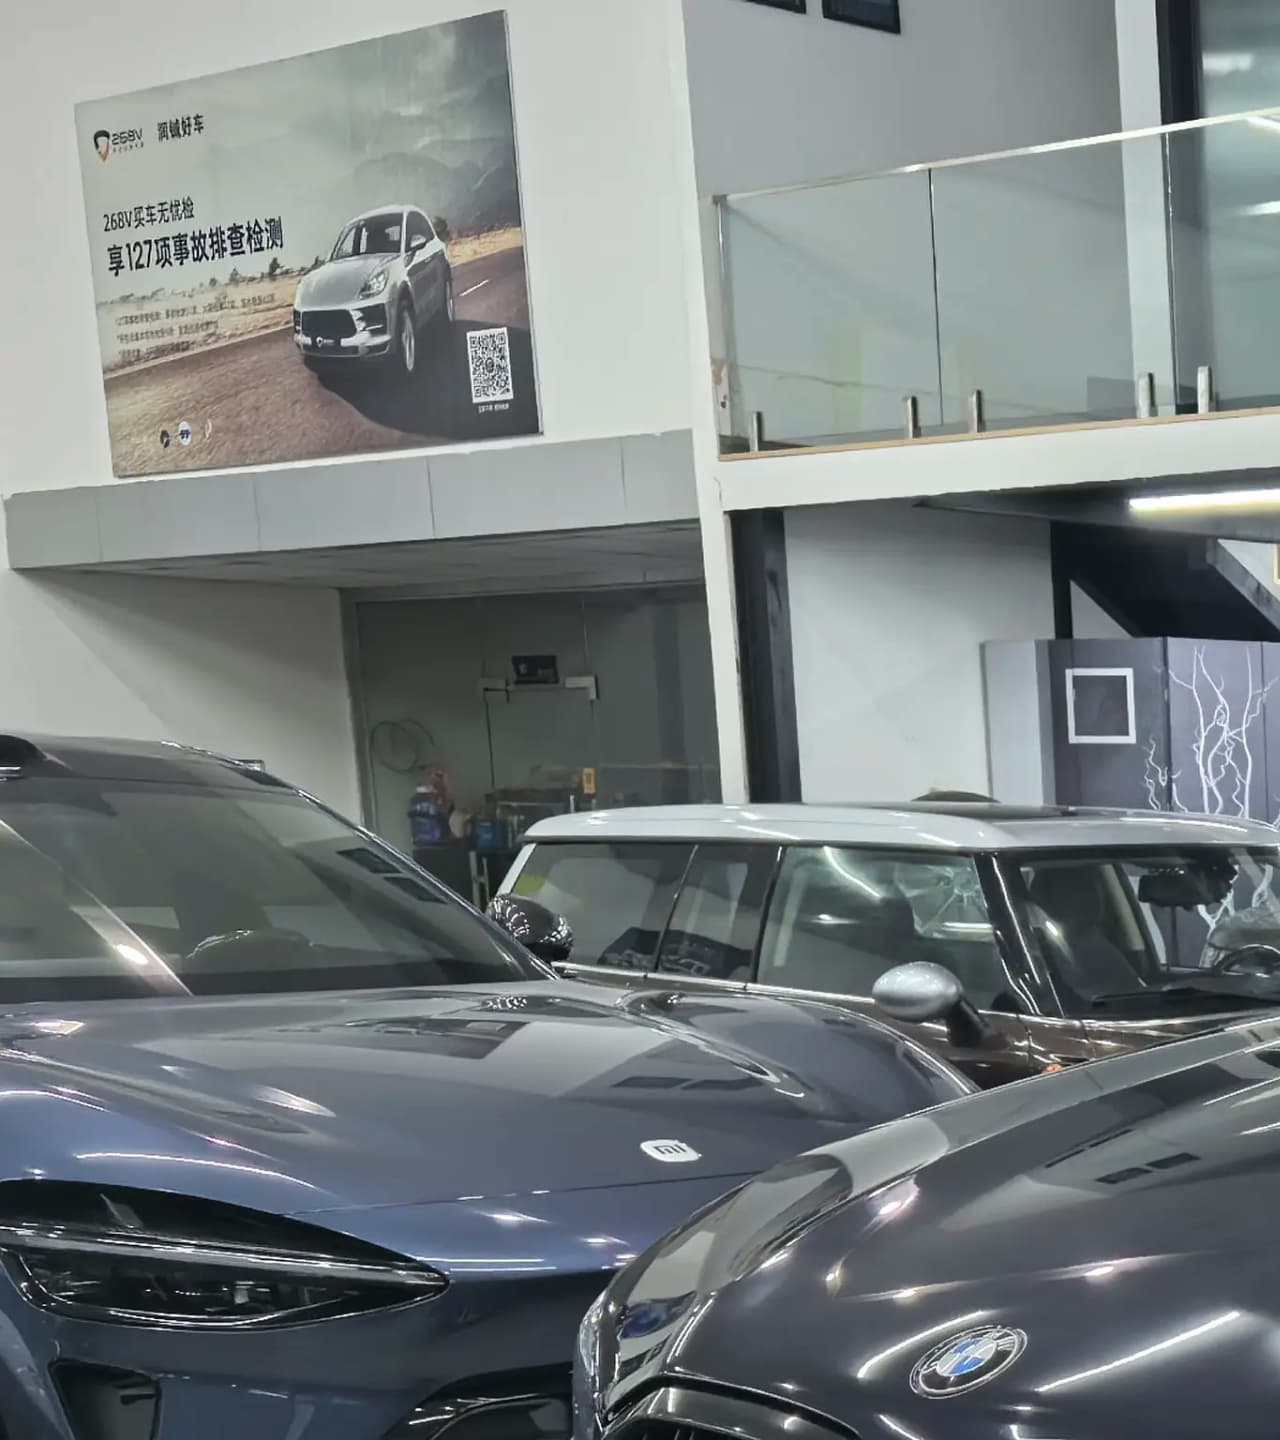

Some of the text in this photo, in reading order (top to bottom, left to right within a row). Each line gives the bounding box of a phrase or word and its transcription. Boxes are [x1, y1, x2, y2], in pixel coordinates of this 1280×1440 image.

[103, 196, 195, 232] 268V买车无忧检
[107, 216, 284, 277] 享127项事故排查检测
